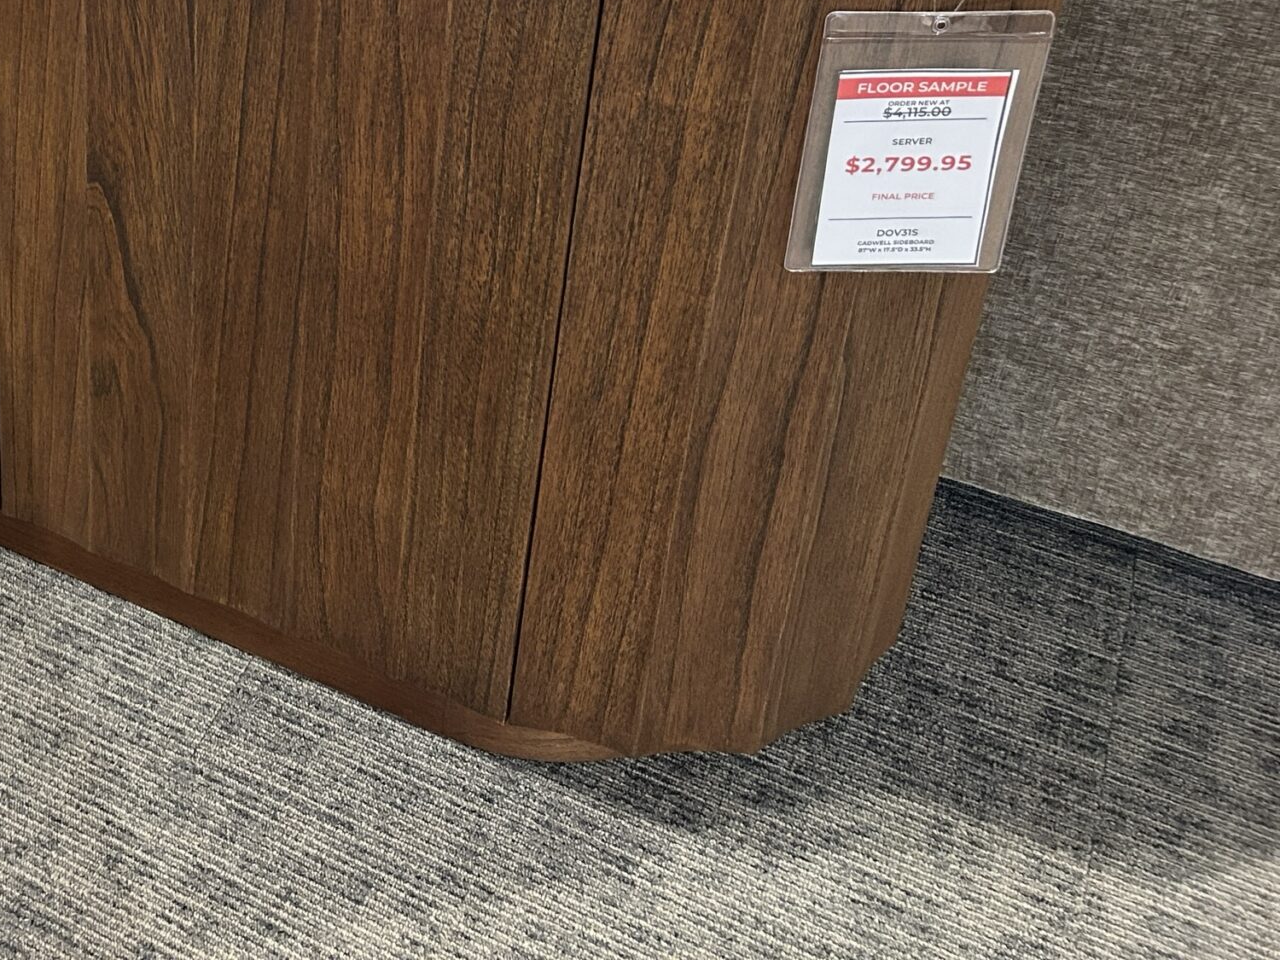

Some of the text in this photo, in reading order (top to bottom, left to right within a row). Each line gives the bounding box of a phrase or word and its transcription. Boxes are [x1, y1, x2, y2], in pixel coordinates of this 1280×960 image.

[857, 81, 988, 94] FLOOR SAMPLE
[883, 106, 952, 119] $4,115.00
[892, 137, 933, 146] SERVER
[845, 155, 972, 175] $2,799.95
[871, 192, 935, 201] FINAL PRICE
[876, 229, 919, 237] DOV31S
